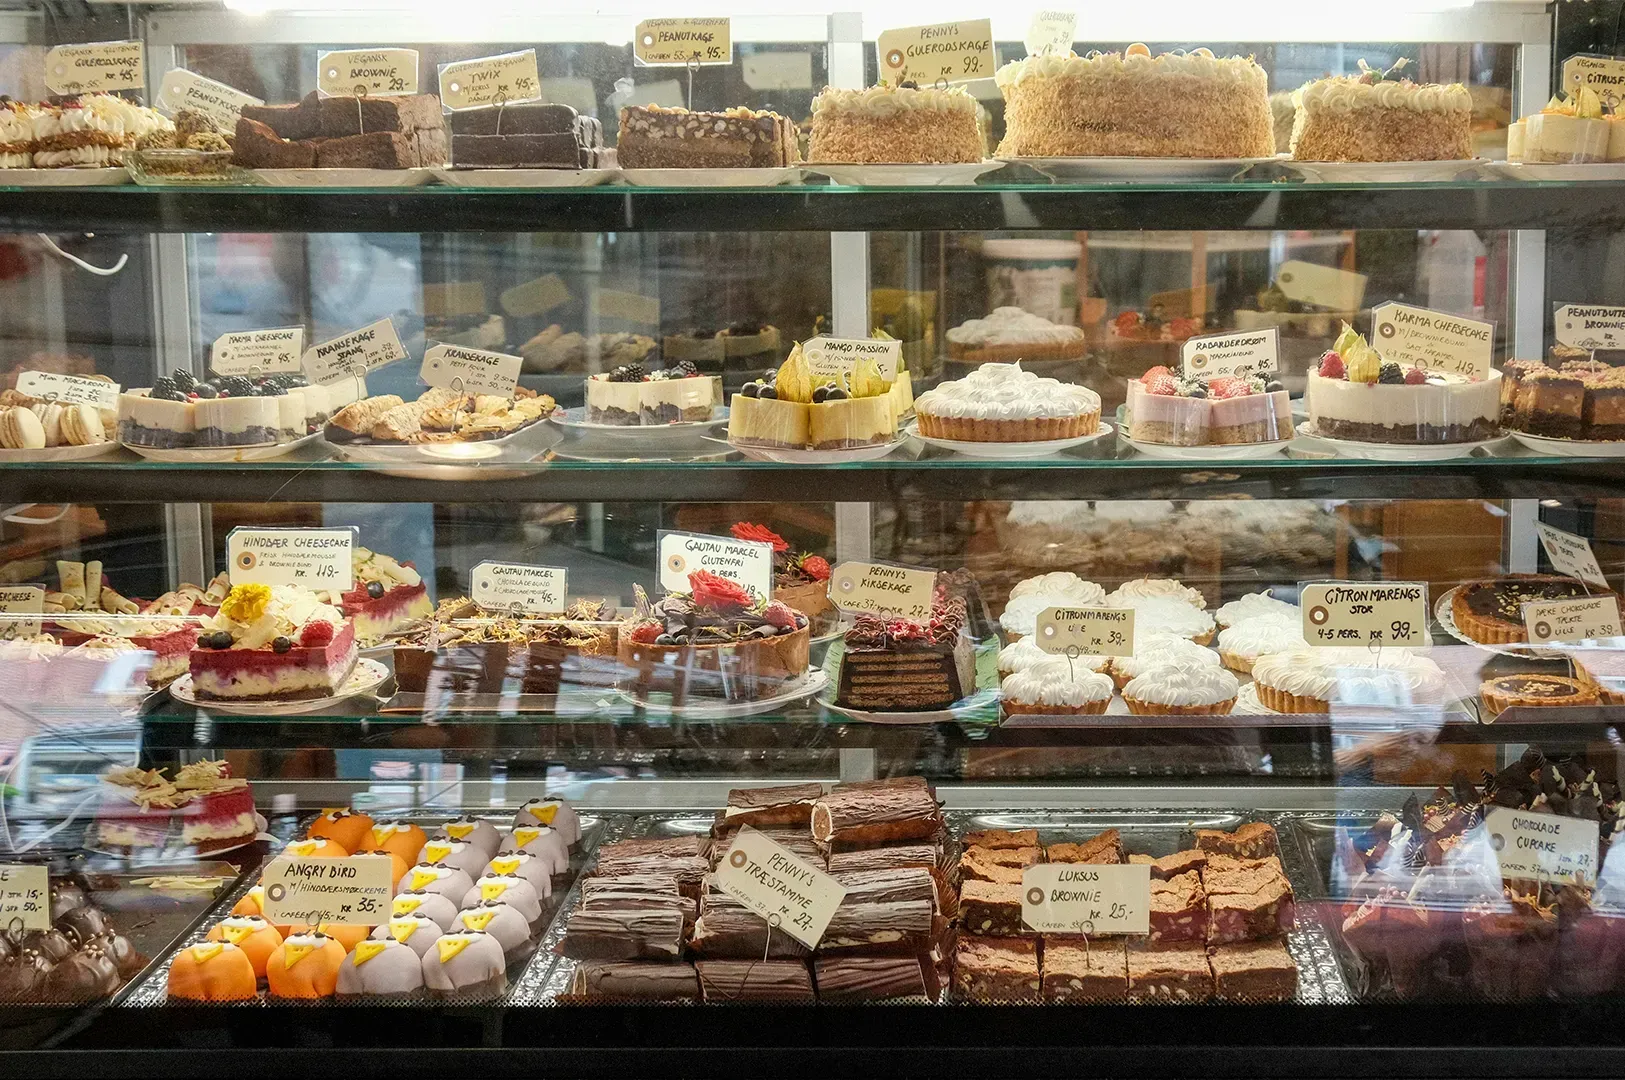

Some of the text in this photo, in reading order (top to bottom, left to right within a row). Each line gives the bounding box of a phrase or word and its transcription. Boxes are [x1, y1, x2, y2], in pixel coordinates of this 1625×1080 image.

[646, 18, 677, 29] VEGANSK
[658, 31, 715, 44] PEANUTKAGE
[707, 46, 726, 60] 45,-
[906, 40, 990, 58] GULERODSKAGE
[75, 57, 140, 67] GULERODSKAGE
[348, 54, 389, 65] VEGANSK
[120, 69, 138, 82] 45,-
[349, 65, 397, 79] BROWNIE
[469, 69, 501, 84] TWIX
[389, 78, 410, 91] 29,-
[515, 78, 534, 91] 45,-
[1394, 309, 1490, 343] KARMA CHEESECAKE
[228, 331, 294, 345] KARMA CHEESECAKE
[823, 341, 890, 355] MANGO PASSION
[278, 353, 295, 364] 45,-
[443, 348, 500, 366] KRANSEKAGE
[1258, 358, 1274, 370] 45,-
[243, 535, 351, 549] HINDBÆR CHEESECAKE
[685, 540, 760, 560] GAUTAU MARCEL
[700, 555, 745, 568] GLUTENFRI
[492, 566, 554, 579] GAUTAU MARCEL
[718, 569, 741, 580] PERS.
[541, 592, 557, 605] 45,-
[909, 604, 930, 618] 27,-
[1349, 604, 1374, 615] STOR
[1560, 600, 1602, 614] CHOKOLADE
[1055, 608, 1128, 624] CITRONMARENGS
[1317, 629, 1335, 639] 4-5
[1336, 629, 1362, 640] PERS.
[1391, 620, 1419, 641] 99,-
[1107, 631, 1127, 647] 39,-
[1511, 817, 1562, 836] CHOKOLADE
[1516, 836, 1557, 853] CUPCAKE
[1577, 855, 1594, 867] 27,-
[283, 862, 358, 880] ANGRY BIRD
[766, 852, 815, 888] PENNY'S
[1058, 870, 1101, 881] LUKSUS
[743, 860, 813, 911] TRÆSTAMME
[26, 889, 44, 901] 15,-
[1050, 888, 1102, 903] BROWNIE
[22, 902, 43, 913] 50,-
[356, 896, 383, 914] 35,-
[1108, 902, 1134, 921] 25,-
[792, 910, 815, 932] 27,-
